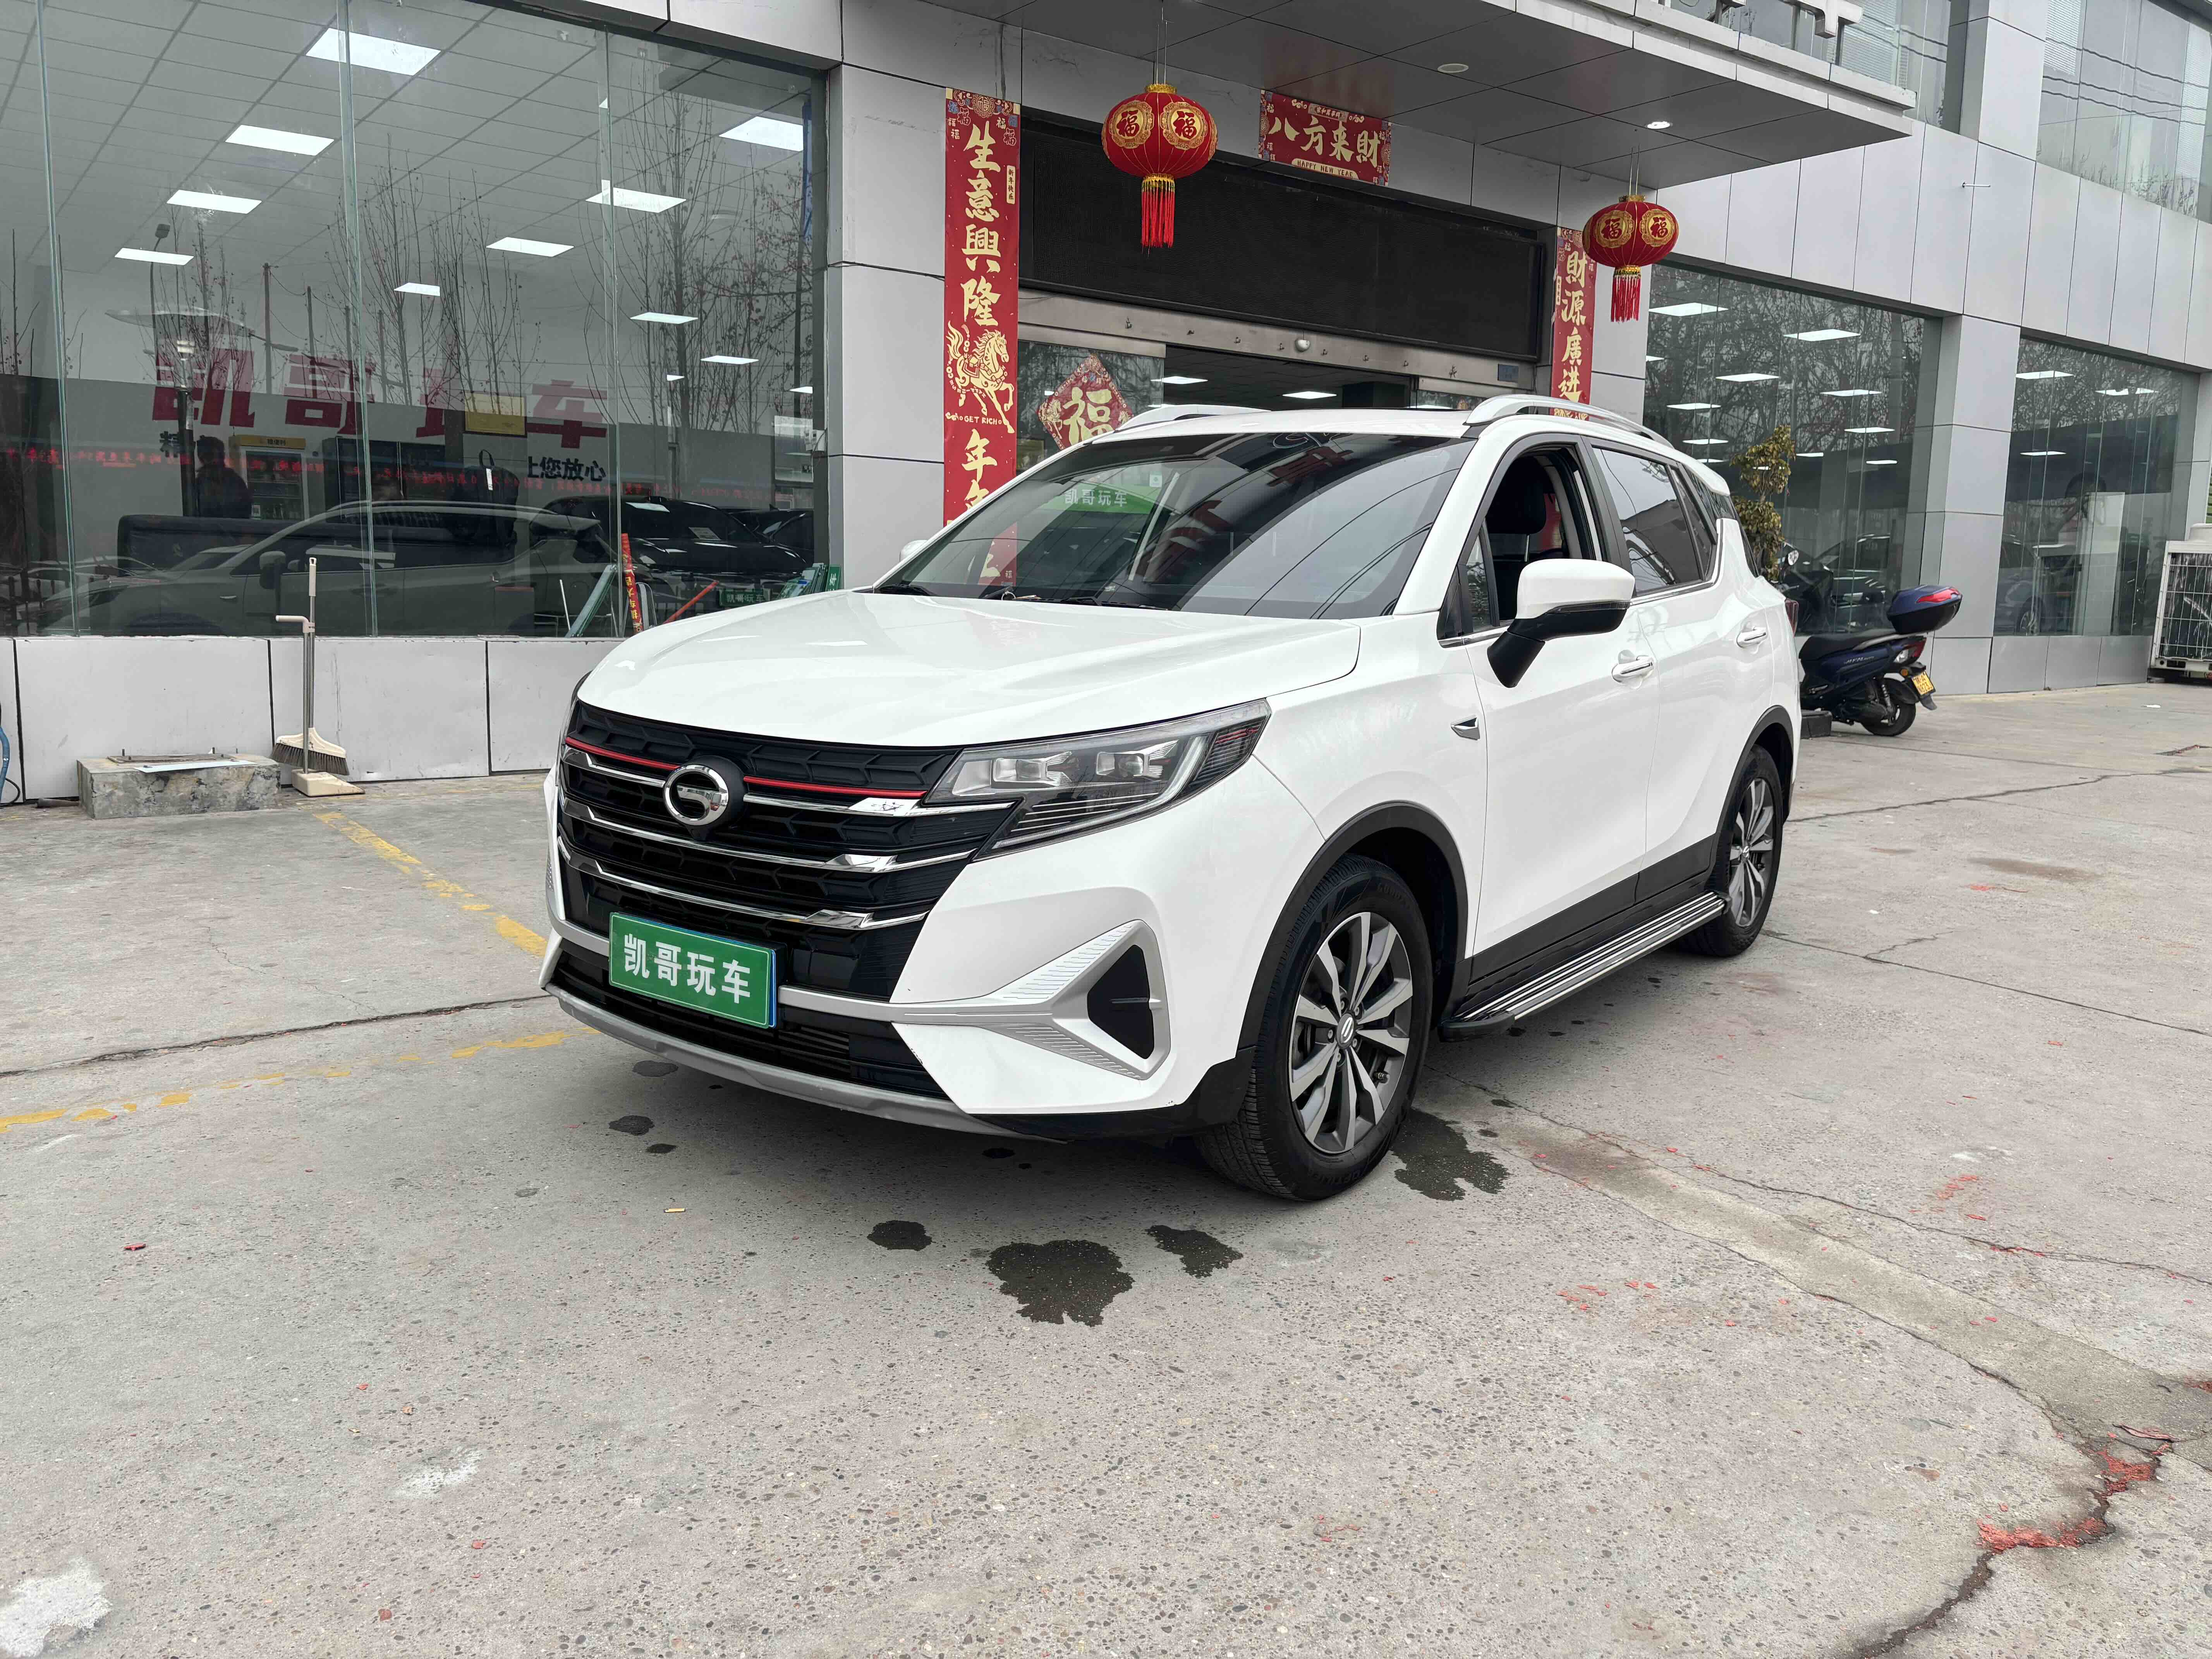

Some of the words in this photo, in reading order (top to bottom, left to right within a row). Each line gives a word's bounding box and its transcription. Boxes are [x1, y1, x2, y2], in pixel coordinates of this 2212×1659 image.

[996, 117, 1006, 129] 福
[1116, 110, 1140, 137] 福
[1173, 111, 1197, 139] 福
[951, 129, 960, 139] 福
[1297, 160, 1317, 170] HAPPY
[1321, 165, 1334, 174] NEW
[1338, 169, 1353, 177] YEAR
[960, 120, 1001, 326] 生意興隆
[1601, 218, 1622, 239] 福
[1650, 216, 1668, 238] 福
[964, 416, 979, 424] GET
[1063, 387, 1115, 446] 福
[1065, 488, 1128, 507] 凯哥玩车
[624, 933, 750, 1004] 凯哥玩车
